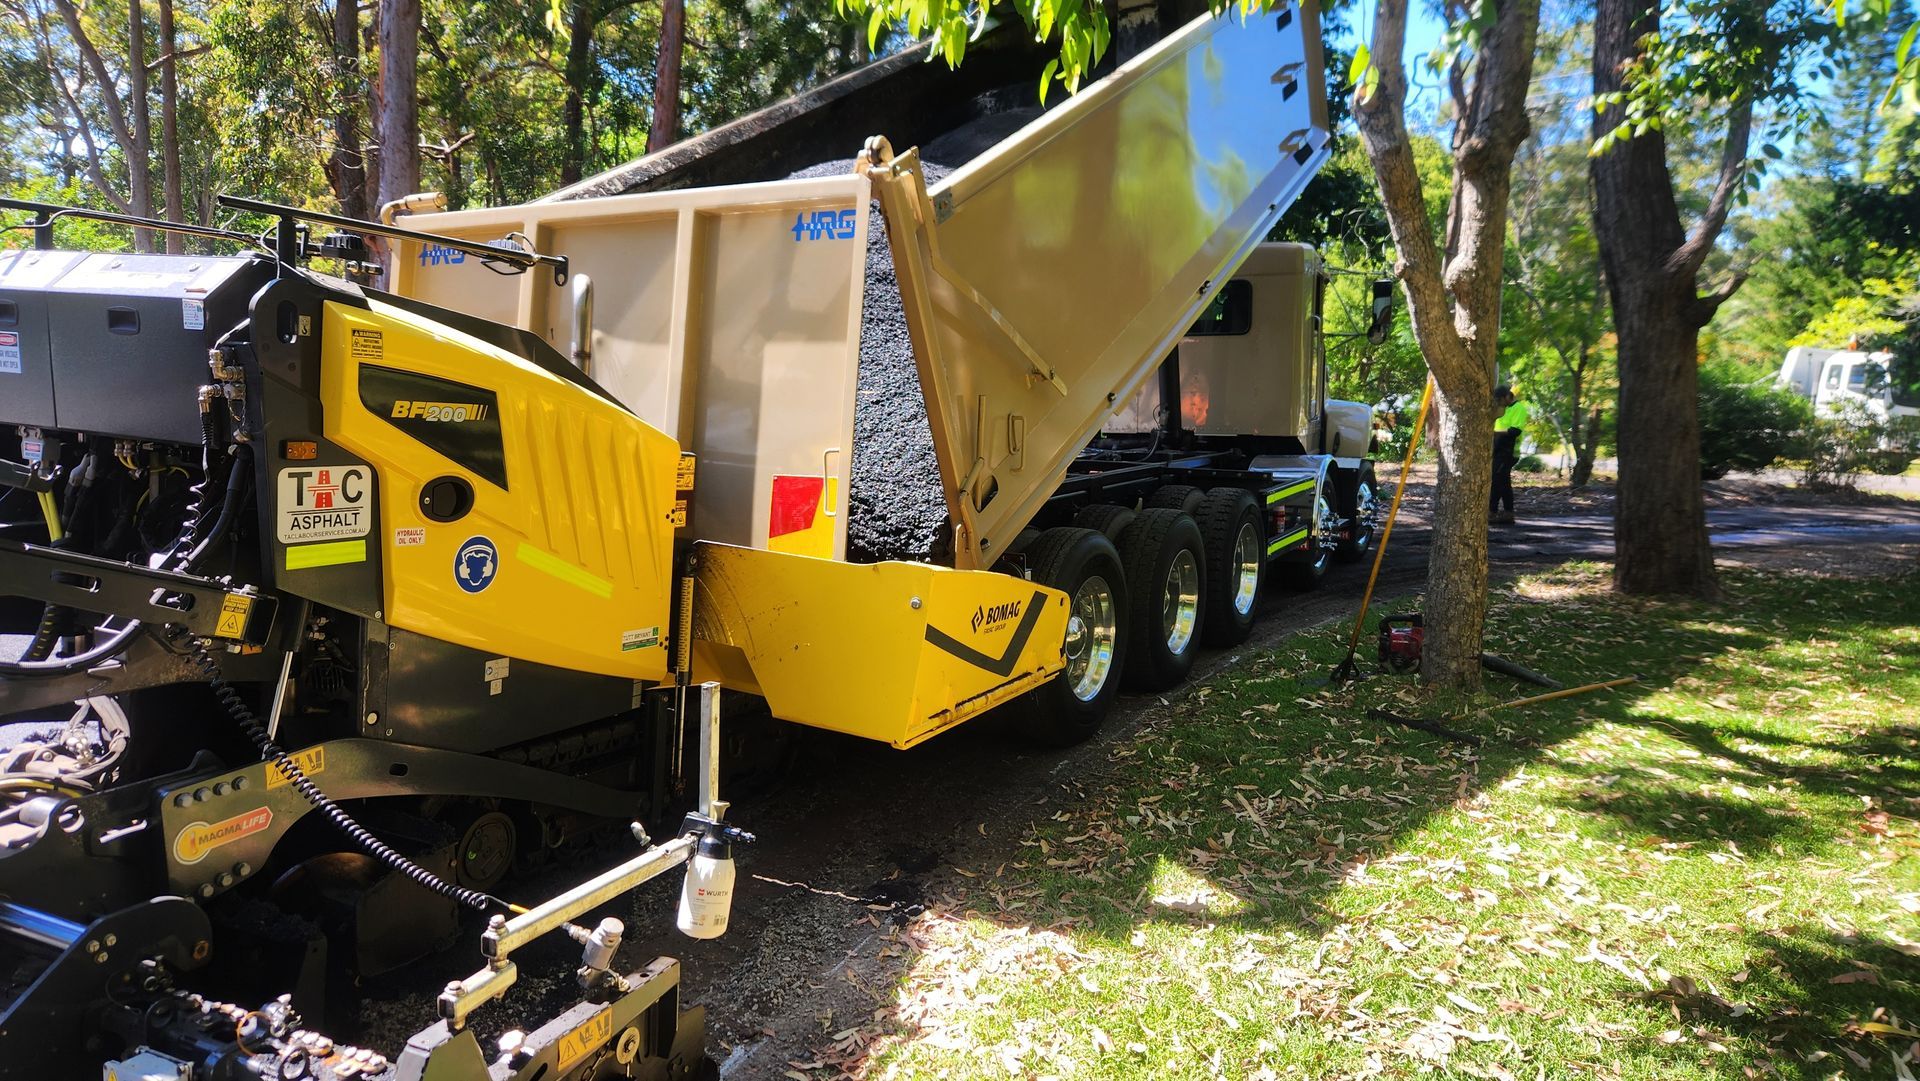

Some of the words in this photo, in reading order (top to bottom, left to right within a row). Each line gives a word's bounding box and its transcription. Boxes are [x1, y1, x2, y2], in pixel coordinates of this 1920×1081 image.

[792, 209, 856, 241] HRS
[803, 221, 854, 231] TRAILERS
[290, 512, 360, 531] ASPHALT
[284, 528, 366, 540] TACLABOURSERVICES.COM.AU
[397, 529, 424, 537] HYDRAULIC
[986, 600, 1021, 625] BOMAG
